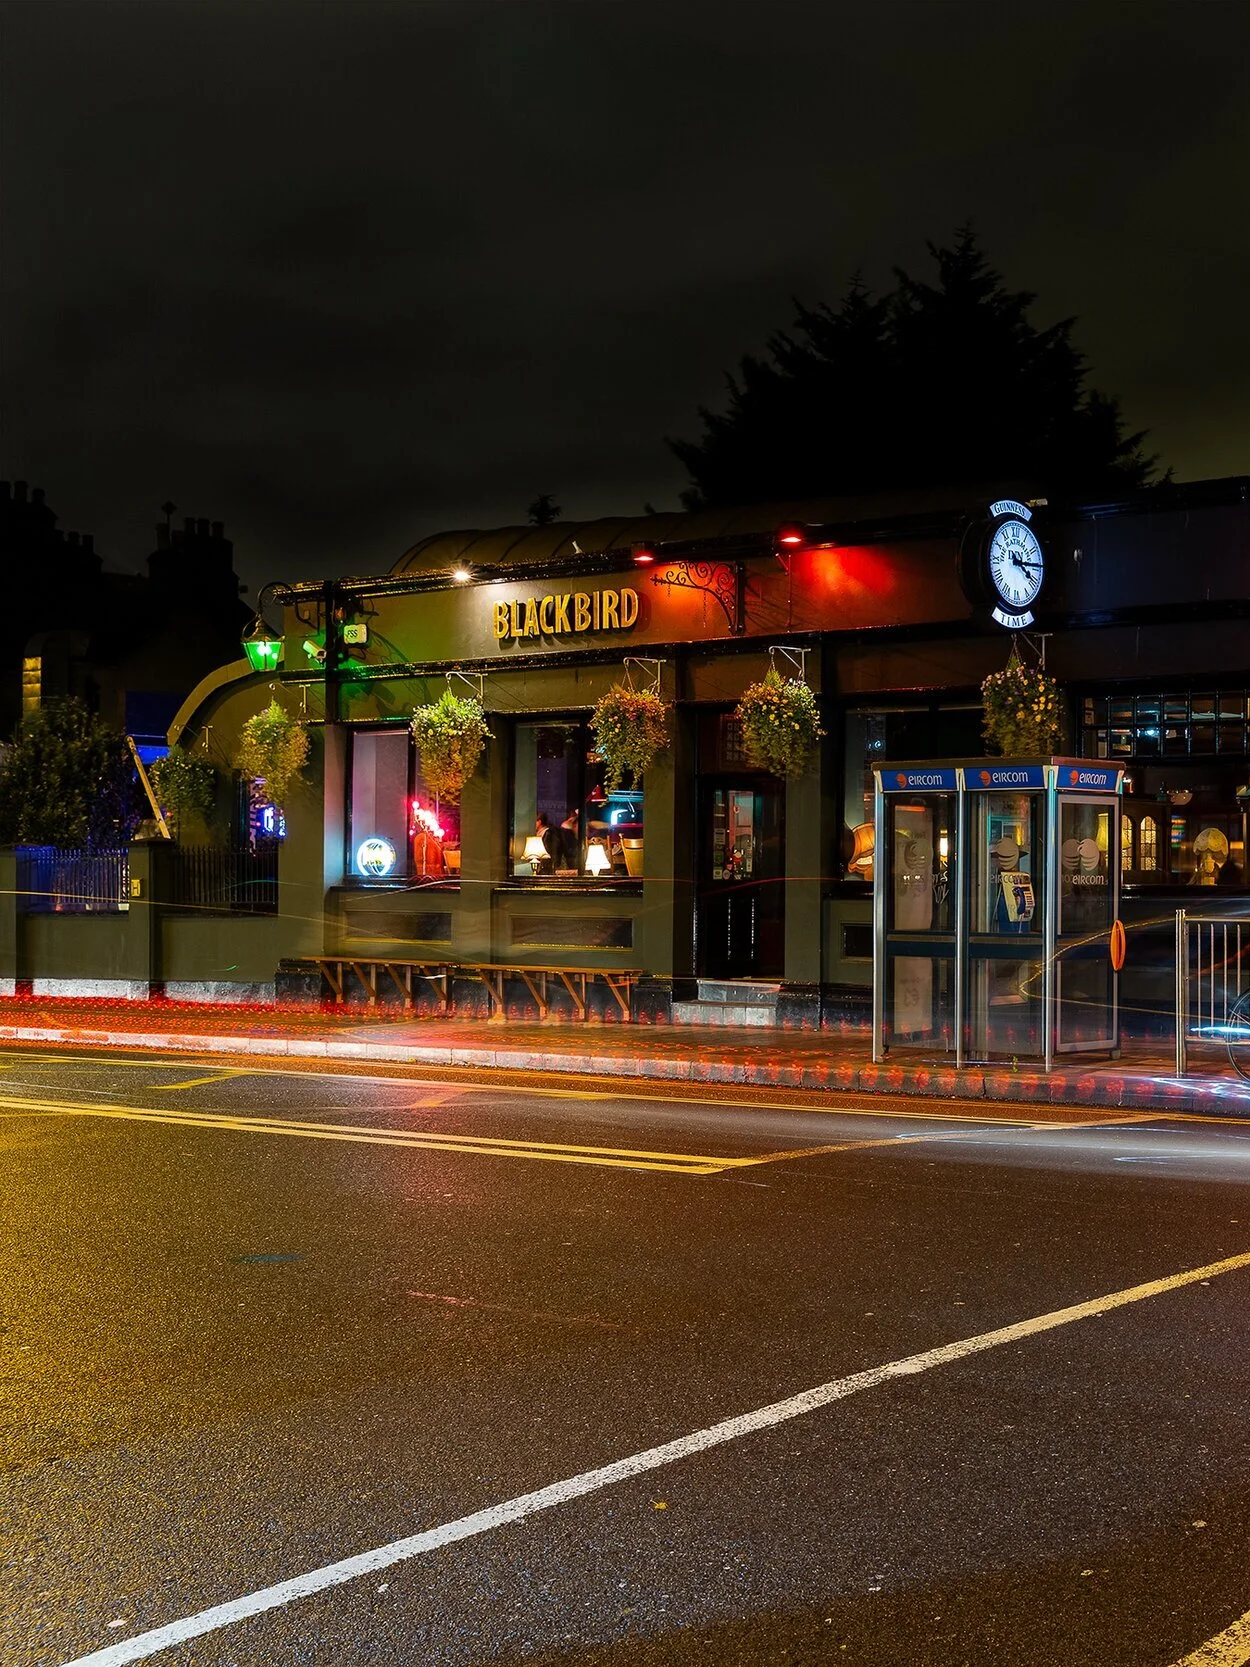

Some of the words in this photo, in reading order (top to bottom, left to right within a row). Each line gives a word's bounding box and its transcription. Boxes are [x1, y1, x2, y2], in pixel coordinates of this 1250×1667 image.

[994, 502, 1026, 517] GUINNESS
[493, 588, 639, 639] BLACKBIRD
[1001, 614, 1028, 627] TIME
